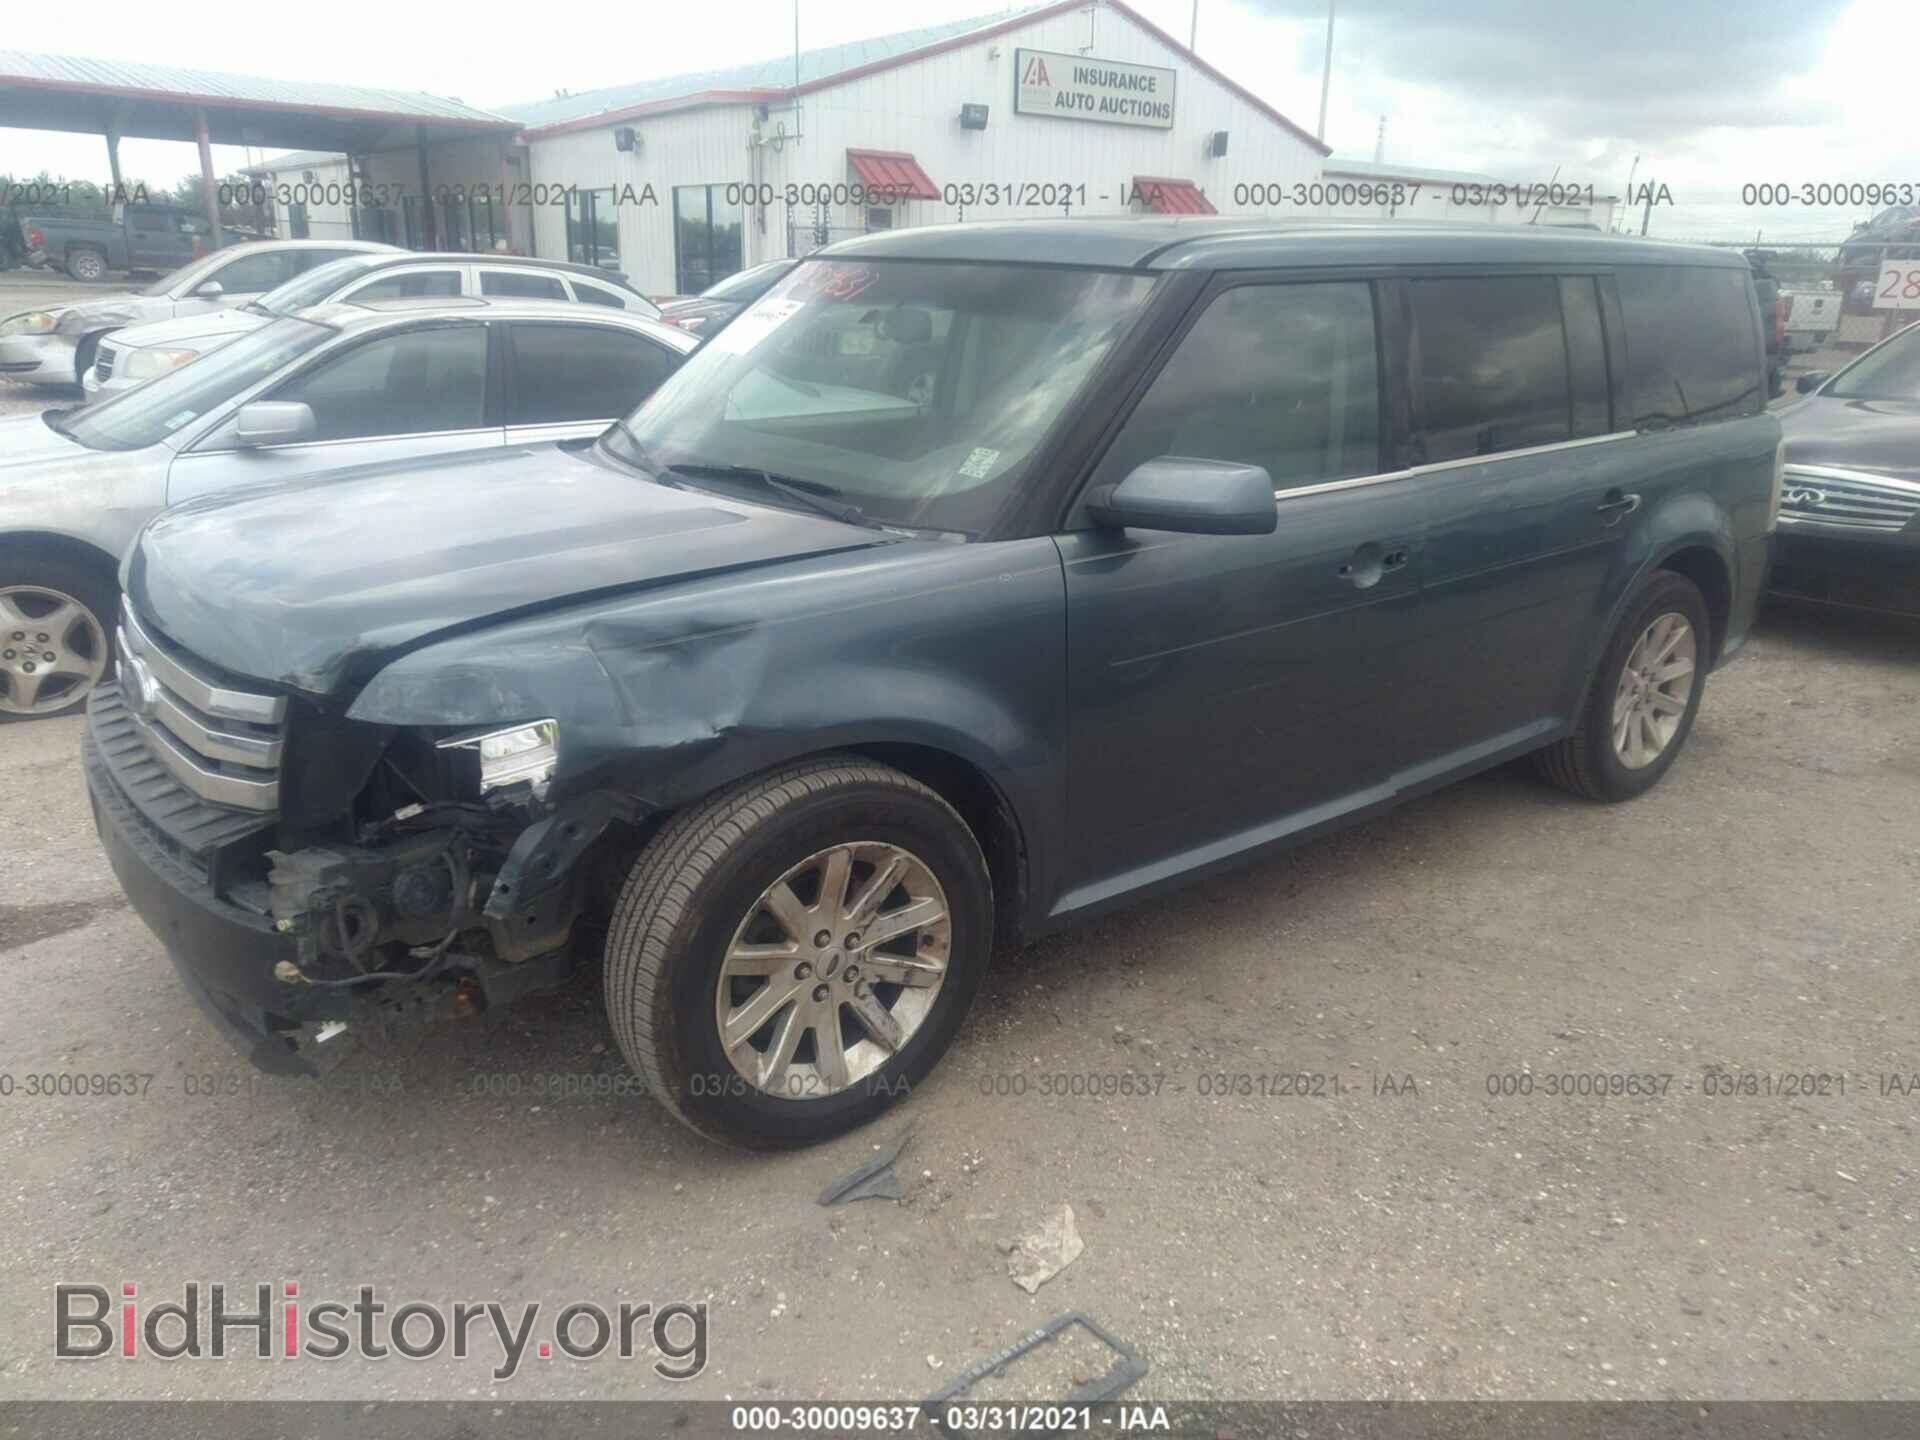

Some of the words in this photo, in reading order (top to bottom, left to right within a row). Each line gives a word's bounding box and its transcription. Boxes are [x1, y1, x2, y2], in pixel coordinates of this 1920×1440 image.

[1073, 65, 1157, 94] INSURANCE
[1055, 90, 1095, 112] AUTO
[1099, 92, 1171, 120] AUCTIONS
[1879, 270, 1920, 299] 28
